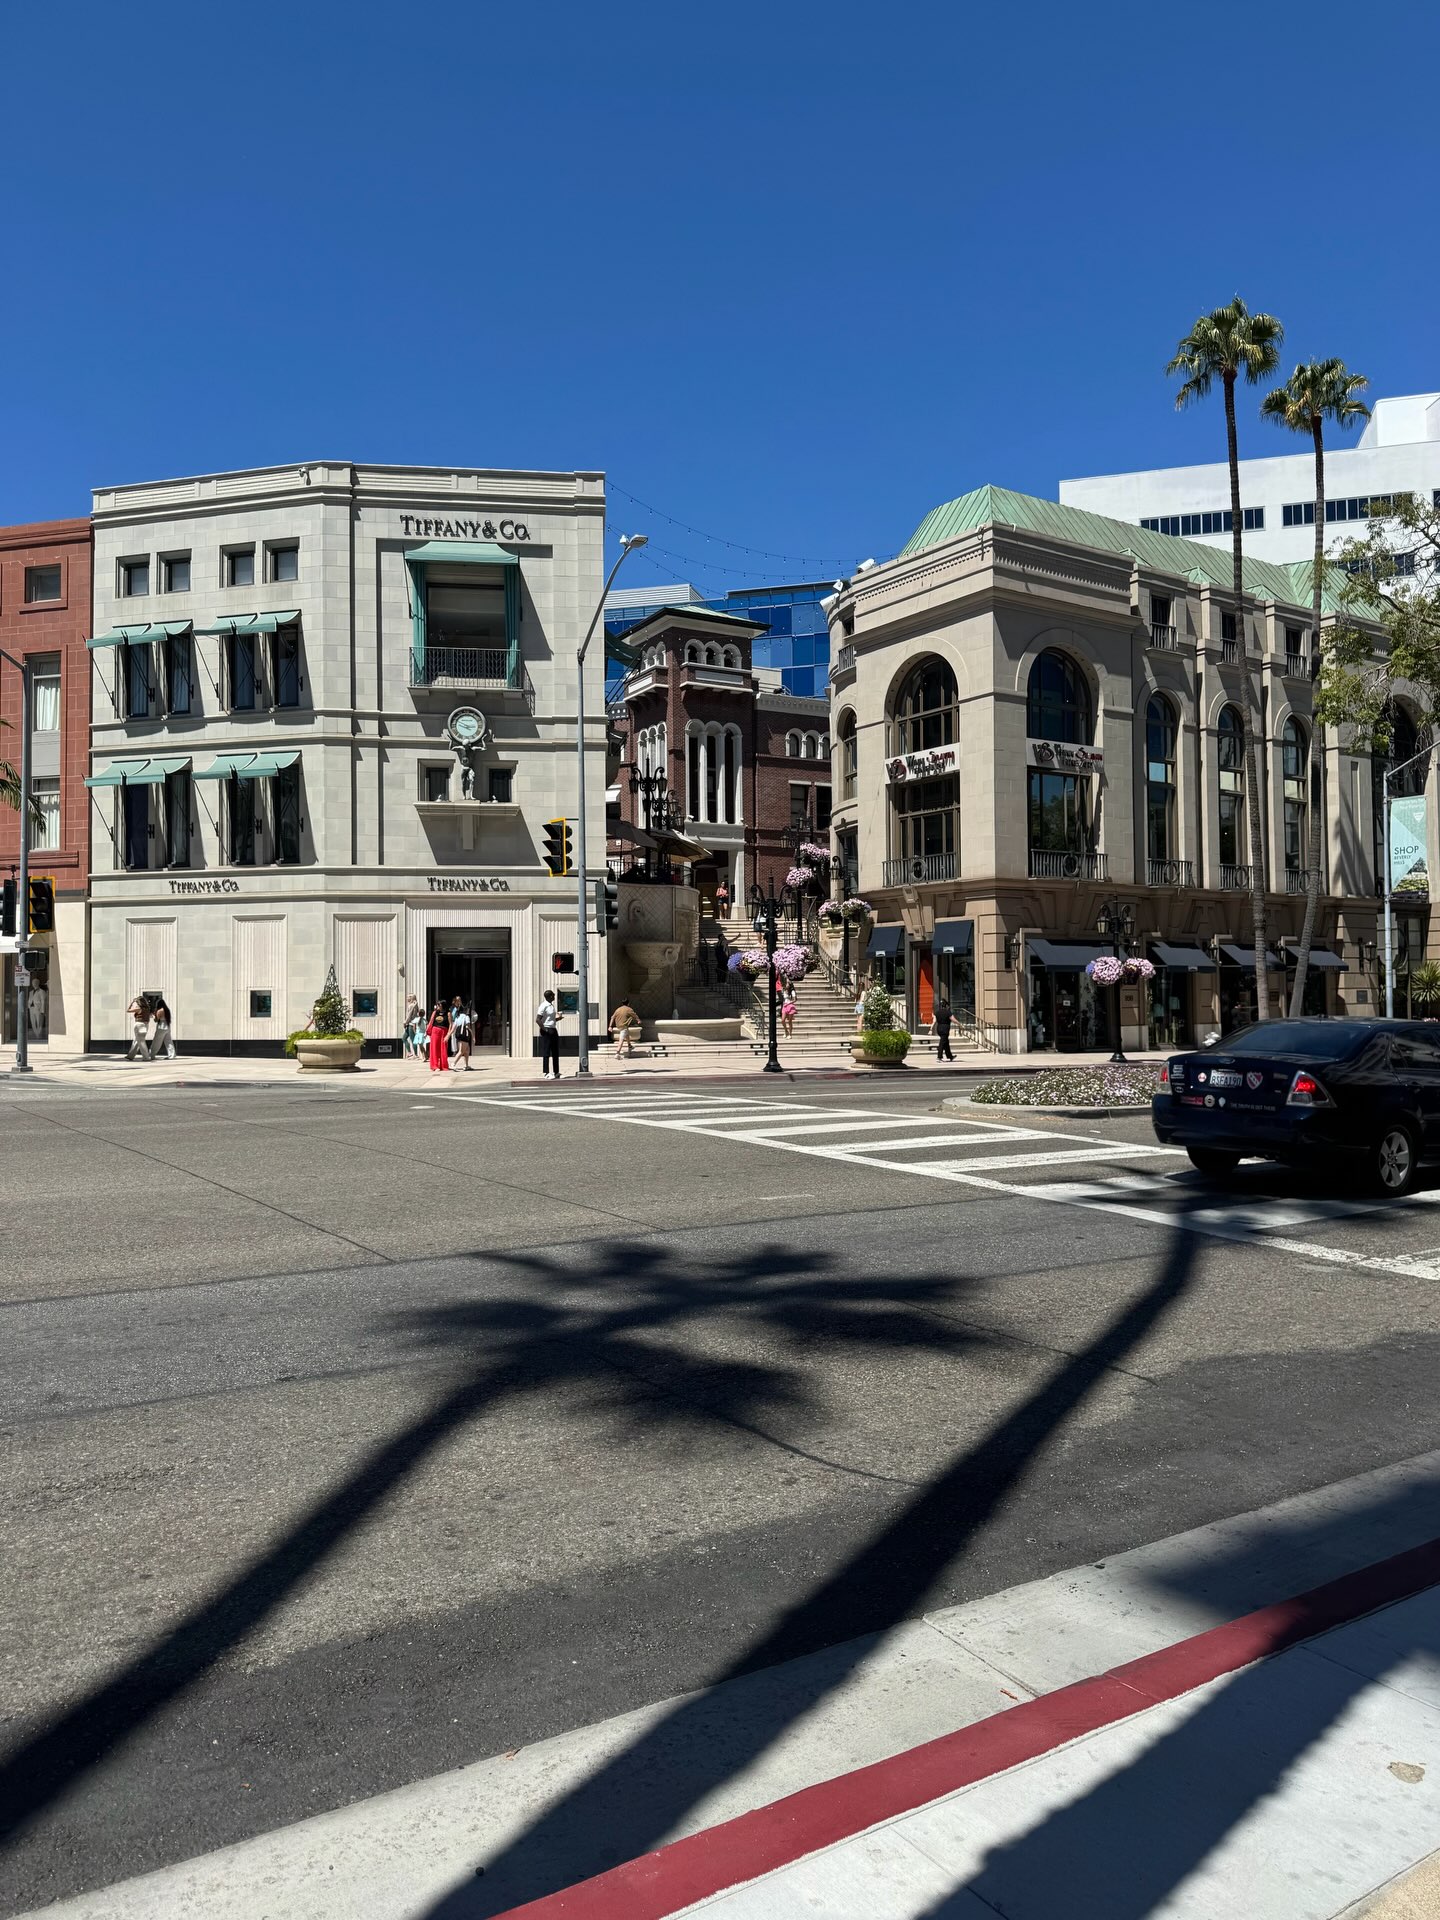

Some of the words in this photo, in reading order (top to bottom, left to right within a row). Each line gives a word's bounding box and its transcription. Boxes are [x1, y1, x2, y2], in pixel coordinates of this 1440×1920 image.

[400, 515, 481, 538] TIFFANY
[1394, 845, 1420, 855] SHOP
[168, 880, 212, 893] TIFFANY
[427, 877, 479, 891] TIFFANY
